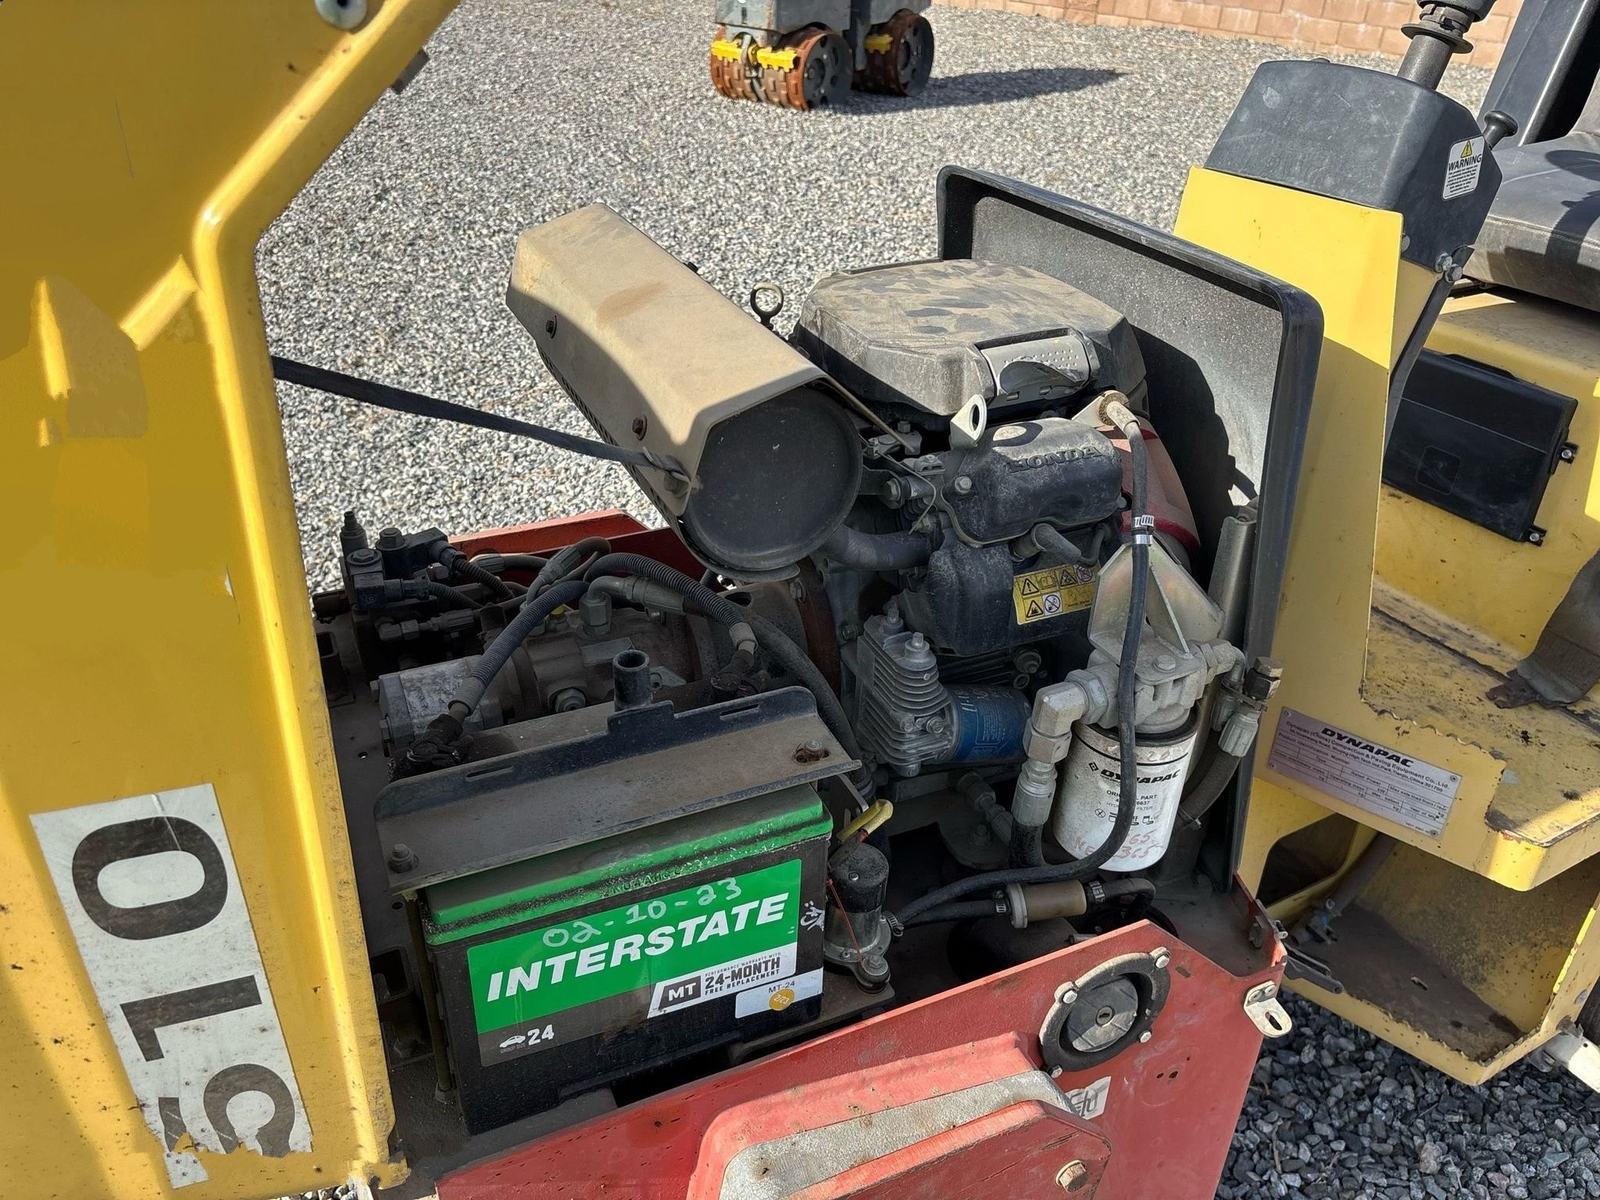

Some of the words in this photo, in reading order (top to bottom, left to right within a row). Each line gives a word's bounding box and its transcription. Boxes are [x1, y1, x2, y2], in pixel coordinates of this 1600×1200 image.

[1449, 154, 1482, 171] WARNING
[1006, 446, 1102, 474] HONDA
[1285, 720, 1310, 734] Dynapac
[1369, 754, 1392, 766] Paving
[1390, 762, 1425, 780] Equipment
[1321, 727, 1414, 767] DYNAPAC
[486, 892, 790, 1003] INTERSTATE
[704, 956, 781, 990] 24-MONTH
[704, 985, 724, 996] FREE
[726, 968, 781, 990] REPLACEMENT
[768, 980, 796, 994] MT-24
[667, 982, 698, 1002] MT
[527, 1024, 555, 1046] 24
